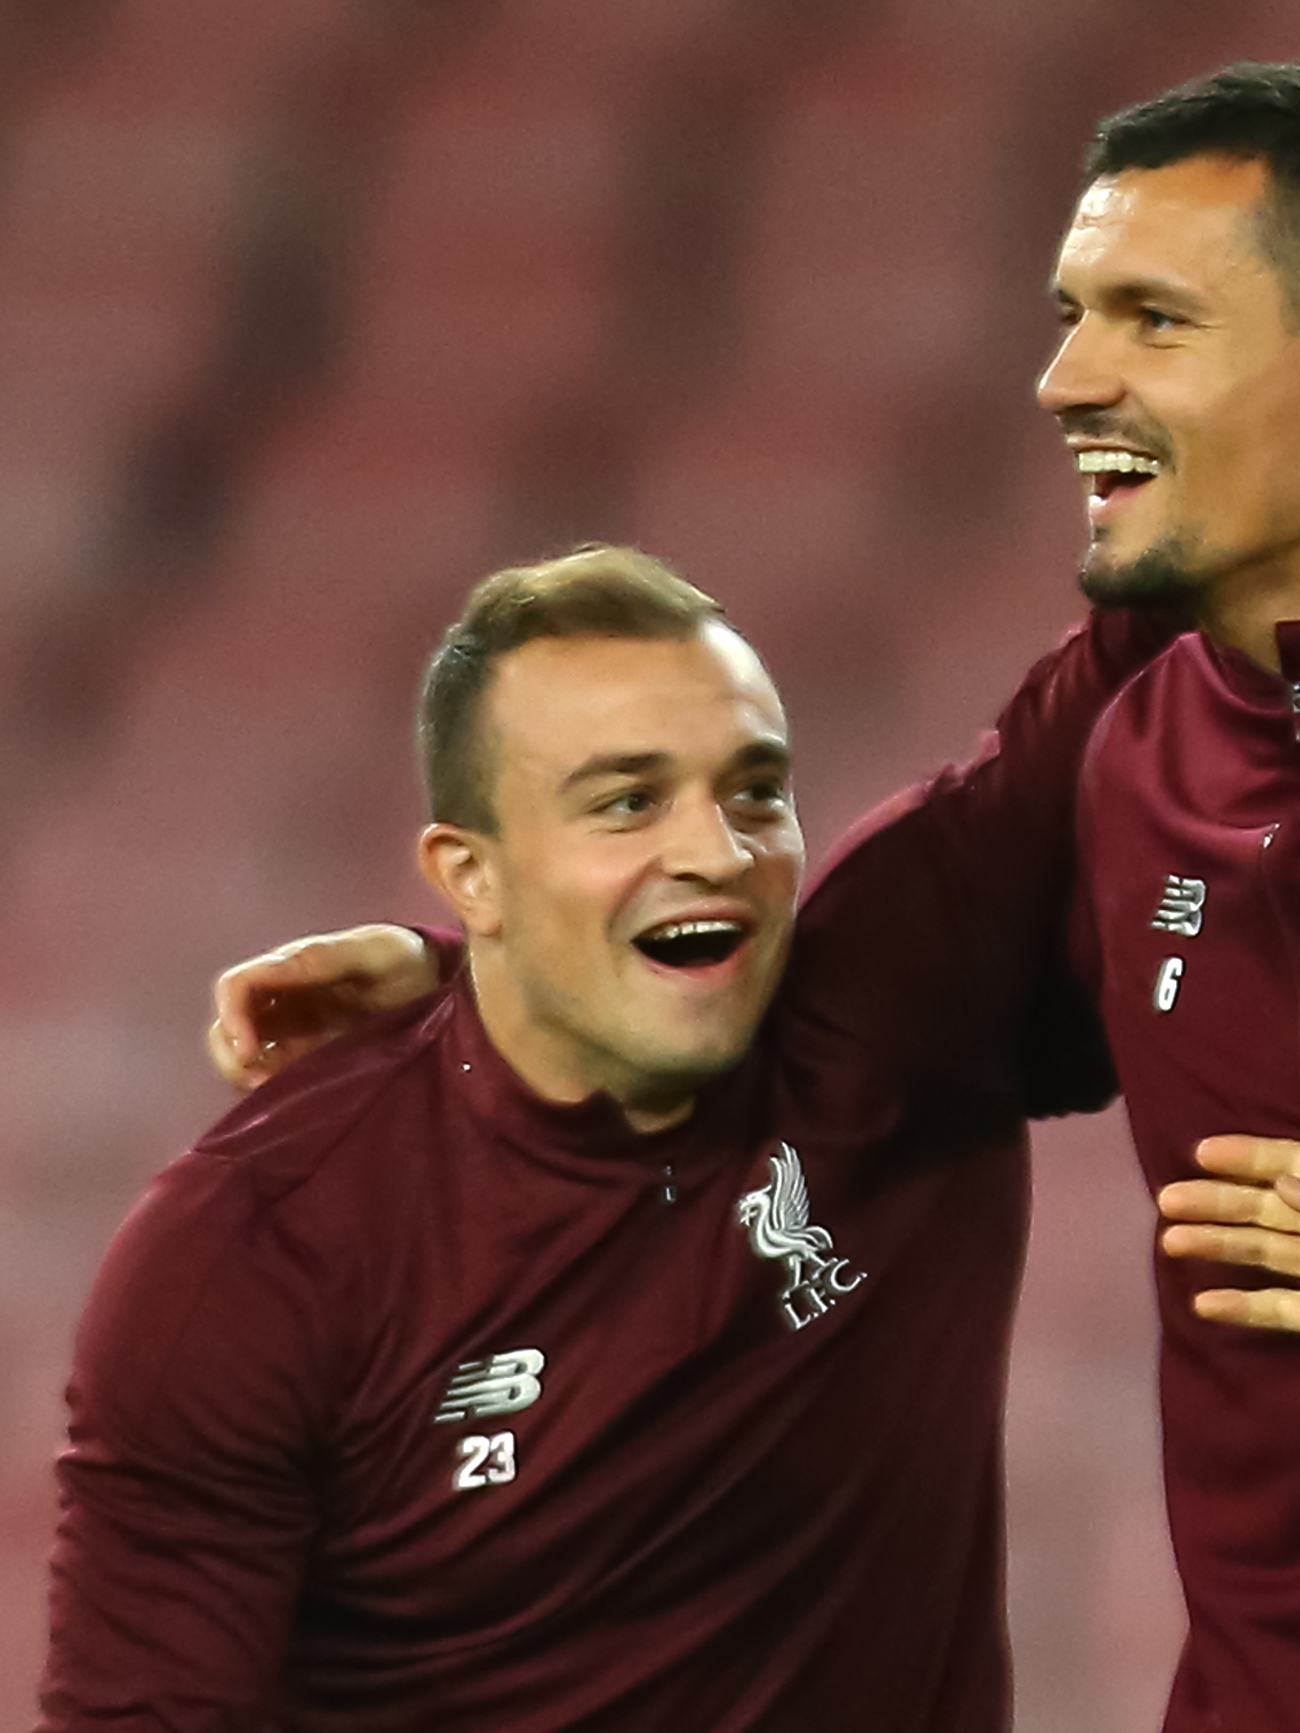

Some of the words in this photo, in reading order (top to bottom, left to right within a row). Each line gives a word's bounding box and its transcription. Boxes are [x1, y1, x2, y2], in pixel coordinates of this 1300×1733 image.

[1154, 957, 1184, 1011] 6
[784, 1258, 868, 1329] L.F.C.
[455, 1431, 516, 1490] 23
